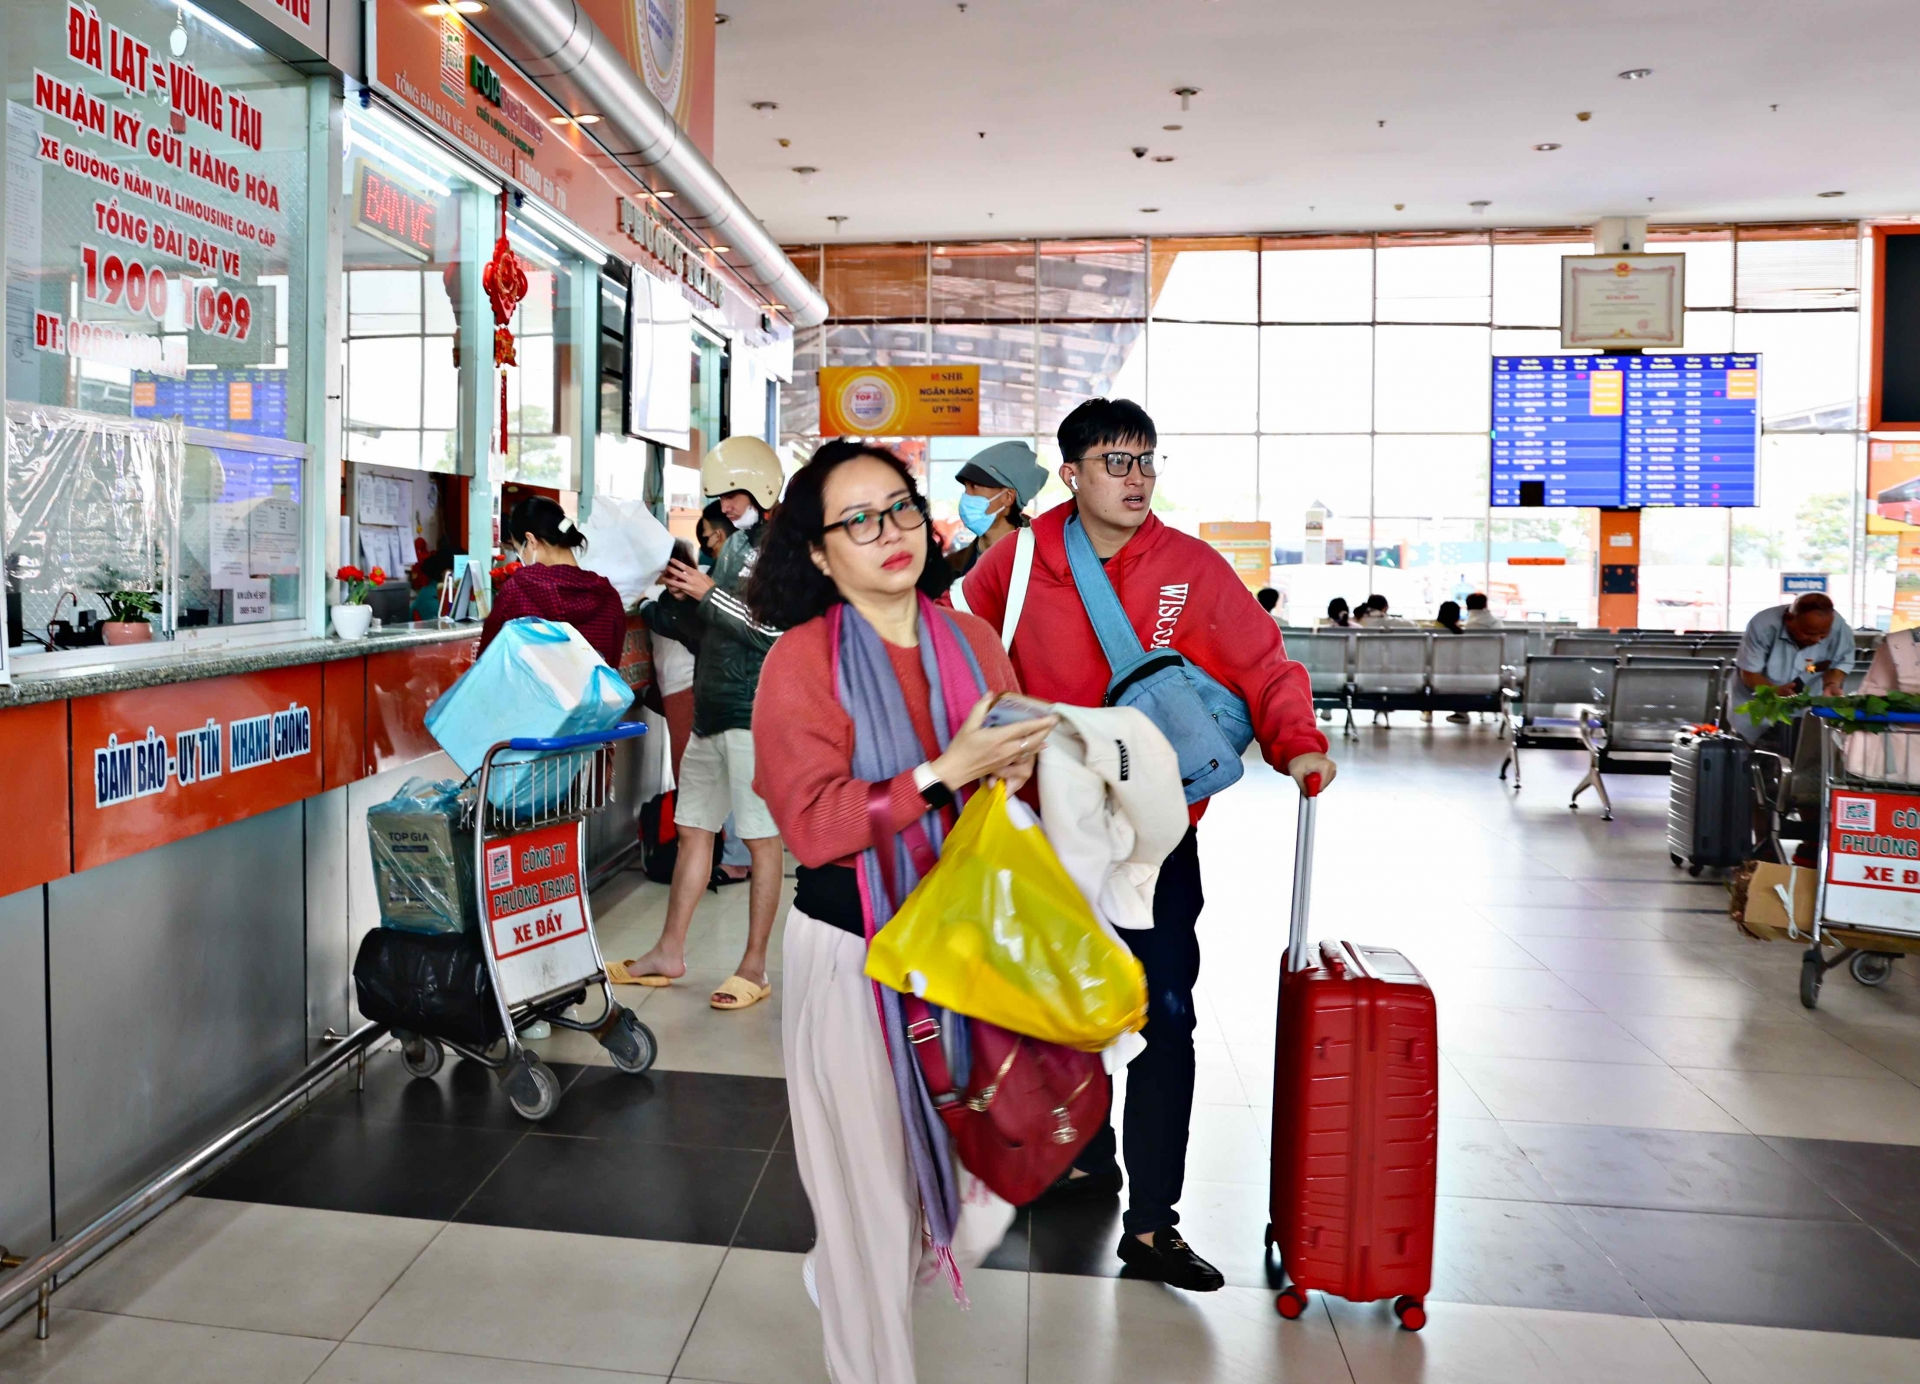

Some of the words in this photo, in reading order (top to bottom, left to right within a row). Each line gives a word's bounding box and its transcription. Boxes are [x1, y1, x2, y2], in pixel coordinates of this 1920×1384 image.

[69, 6, 103, 71] ĐÀ
[110, 28, 149, 95] LẠT
[228, 94, 262, 152] TÀU
[36, 73, 105, 135] NHẬN
[147, 127, 182, 169] GỬI
[189, 146, 240, 193] HÀNG
[41, 136, 59, 161] XE
[64, 148, 120, 185] GIƯỜNG
[175, 193, 233, 233] LIMOUSINE
[236, 219, 256, 240] CAO
[95, 200, 148, 245] TỔNG
[153, 223, 183, 258] ĐÀI
[188, 238, 218, 272] ĐẶT
[83, 247, 167, 318] 1900
[181, 276, 251, 341] 1099
[36, 313, 63, 348] ĐT:
[941, 372, 963, 381] SHB
[932, 405, 944, 414] UY
[1150, 582, 1189, 650] WISCO
[98, 738, 133, 804] ĐẢM
[138, 729, 167, 792] BẢO
[178, 733, 196, 783] UY
[199, 720, 220, 776] TÍN
[232, 718, 271, 769] NHANH
[273, 702, 310, 758] CHÓNG
[388, 832, 409, 842] TOP
[1892, 808, 1920, 829] CÔ
[521, 846, 552, 874] CÔNG
[553, 843, 567, 865] TY
[1863, 865, 1895, 882] XE
[1902, 869, 1920, 884] Đ
[493, 885, 540, 917] PHƯƠNG
[540, 874, 576, 902] TRANG
[512, 923, 533, 945] XE
[535, 908, 562, 938] ĐẨY
